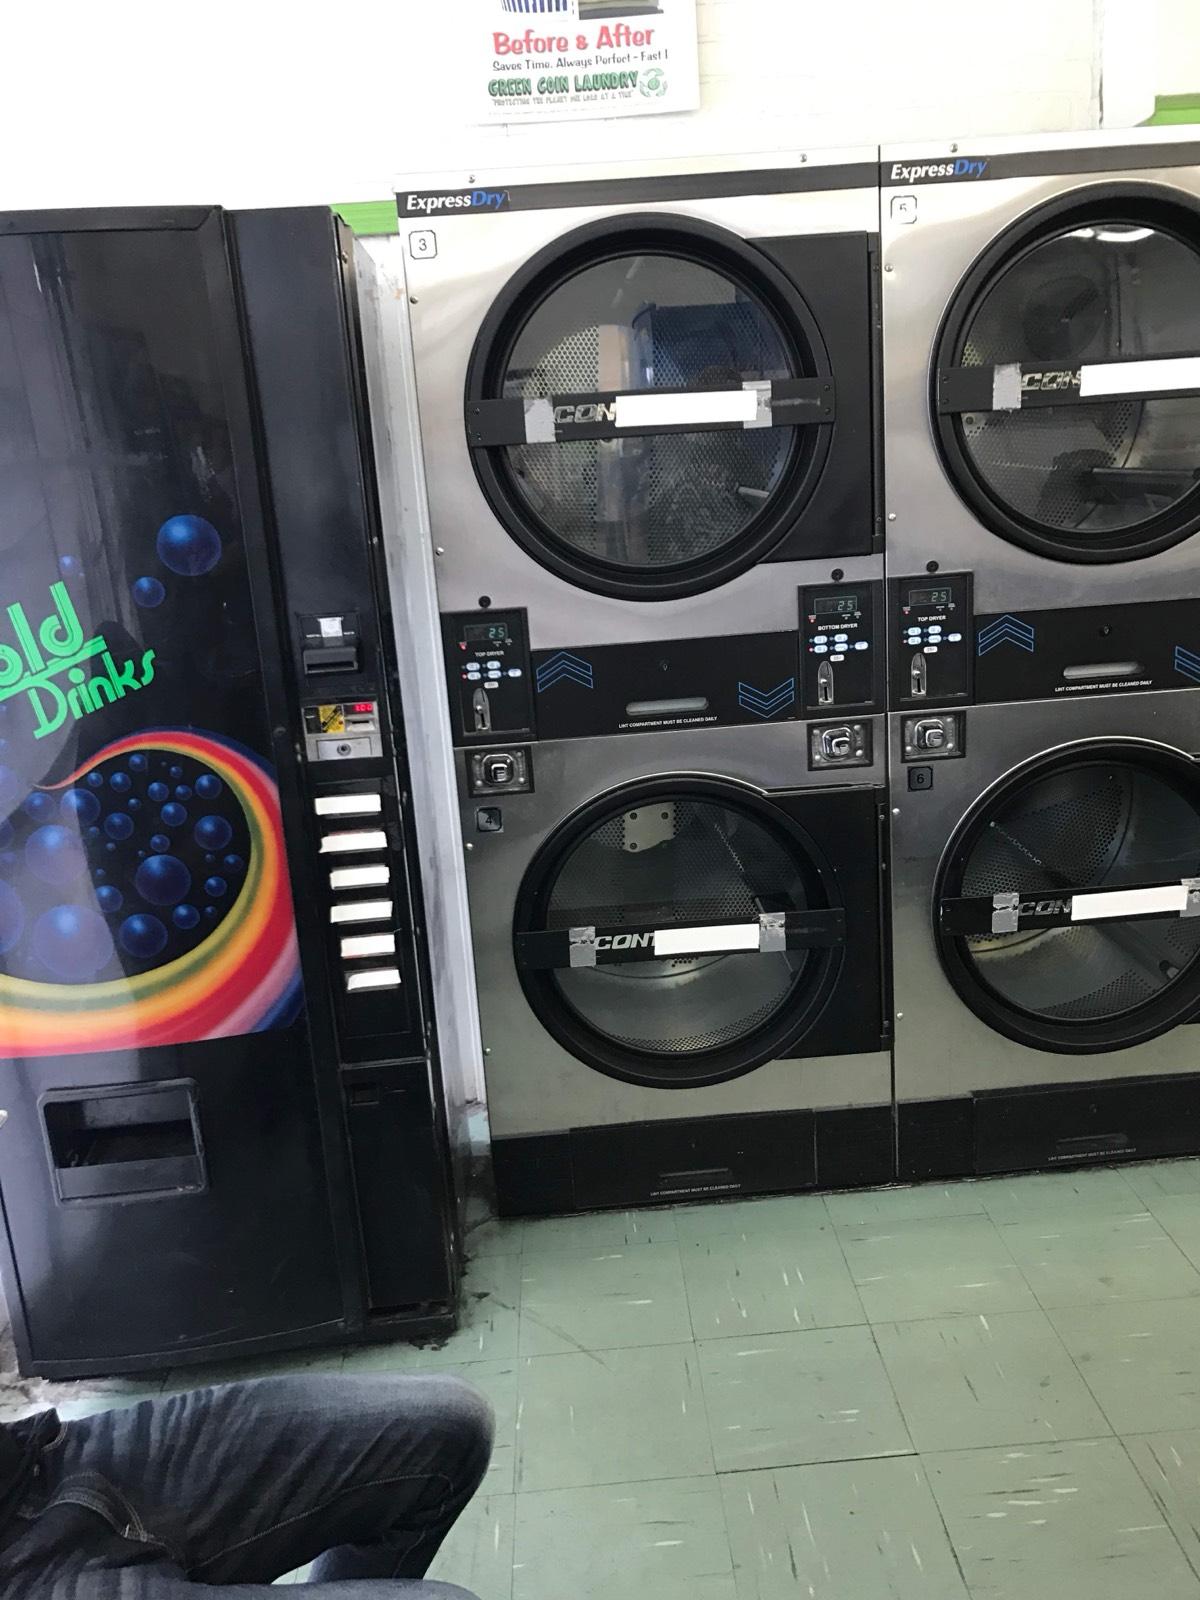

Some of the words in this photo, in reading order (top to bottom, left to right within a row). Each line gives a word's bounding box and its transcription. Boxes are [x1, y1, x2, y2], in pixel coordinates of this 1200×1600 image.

[493, 29, 569, 55] Before
[576, 34, 589, 50] &
[596, 23, 655, 50] After
[492, 60, 522, 72] Saves
[556, 56, 593, 69] Always
[595, 52, 631, 65] Perfect
[641, 50, 662, 61] Fast
[488, 78, 532, 97] GREEN
[537, 75, 569, 94] COIN
[574, 70, 639, 92] LAUNDRY
[418, 238, 428, 252] 3
[931, 591, 947, 603] 25
[837, 600, 854, 612] 25
[0, 581, 104, 696] old
[488, 627, 505, 639] 25
[27, 649, 156, 740] Drinks
[916, 773, 925, 785] 6
[484, 815, 493, 826] 4
